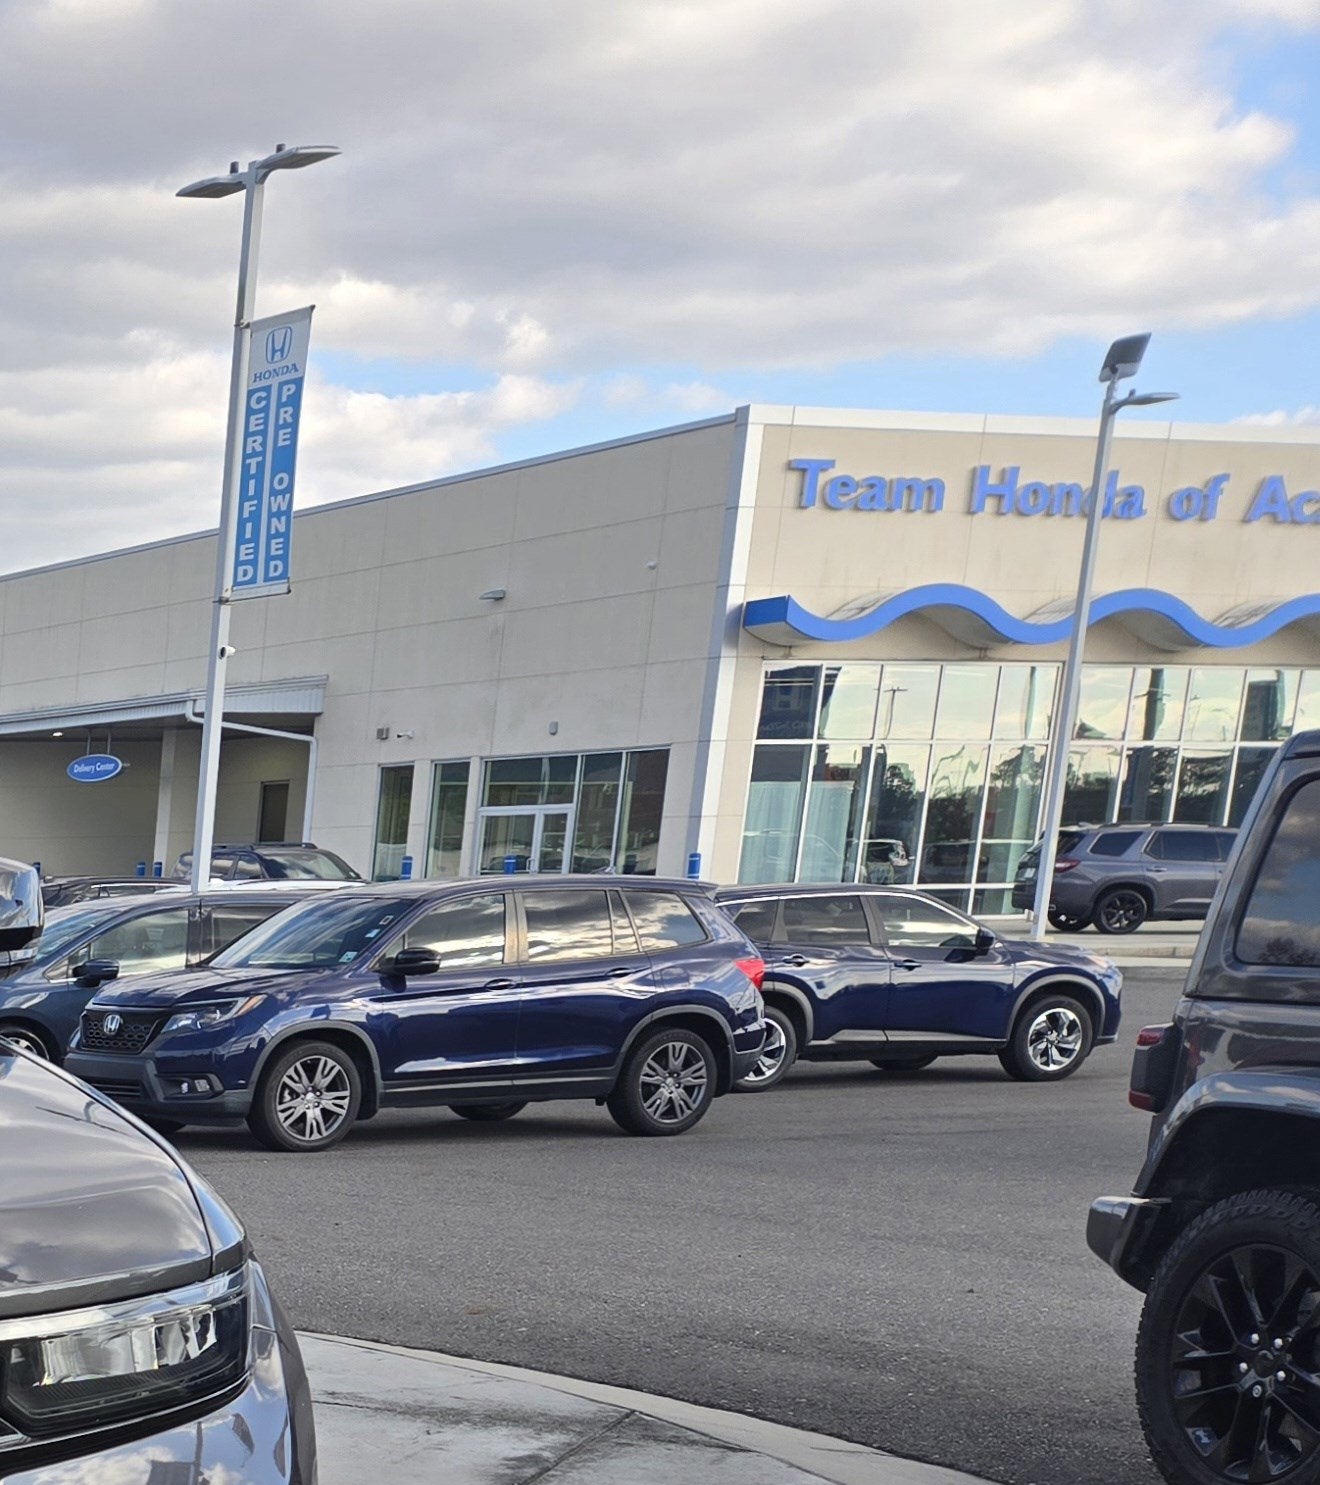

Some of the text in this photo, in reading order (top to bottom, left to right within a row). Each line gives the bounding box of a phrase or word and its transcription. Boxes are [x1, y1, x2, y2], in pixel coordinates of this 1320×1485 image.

[253, 362, 300, 383] HONDA
[236, 391, 267, 582] CERTIFIED
[269, 383, 296, 578] PRE OWNED
[789, 458, 946, 513] Team
[1169, 473, 1230, 521] of
[73, 762, 115, 774] Delivery Center
